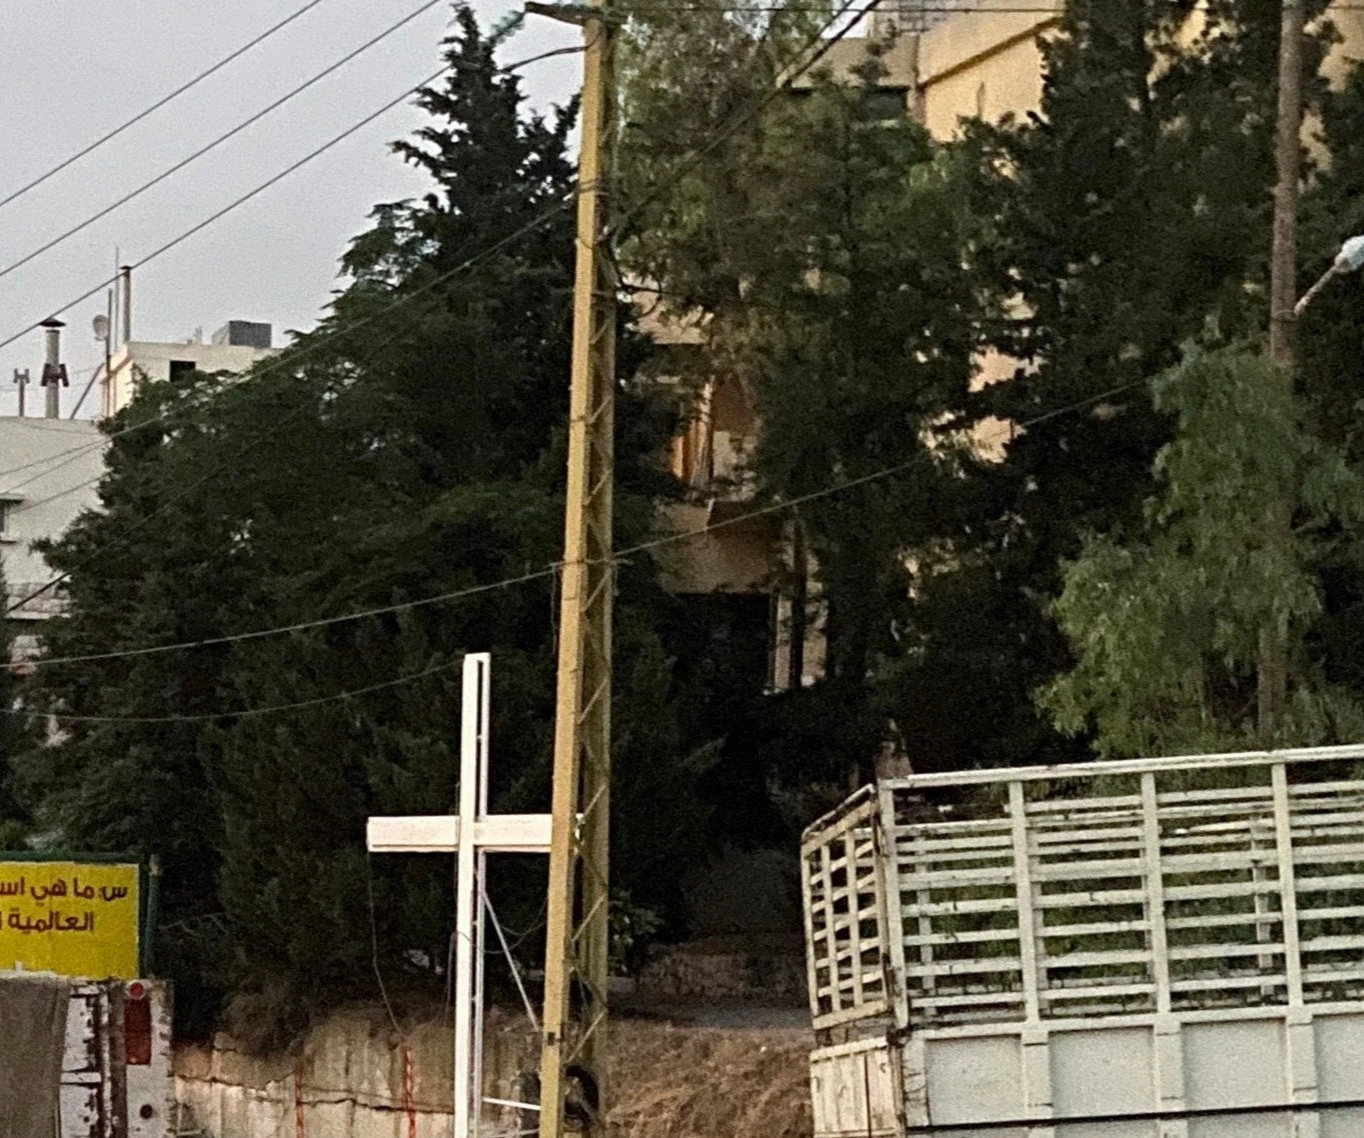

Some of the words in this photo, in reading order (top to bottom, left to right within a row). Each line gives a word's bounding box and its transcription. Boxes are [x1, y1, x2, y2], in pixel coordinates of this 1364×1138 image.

[30, 878, 67, 907] هي
[73, 877, 95, 900] ما
[8, 907, 94, 935] العالمية
